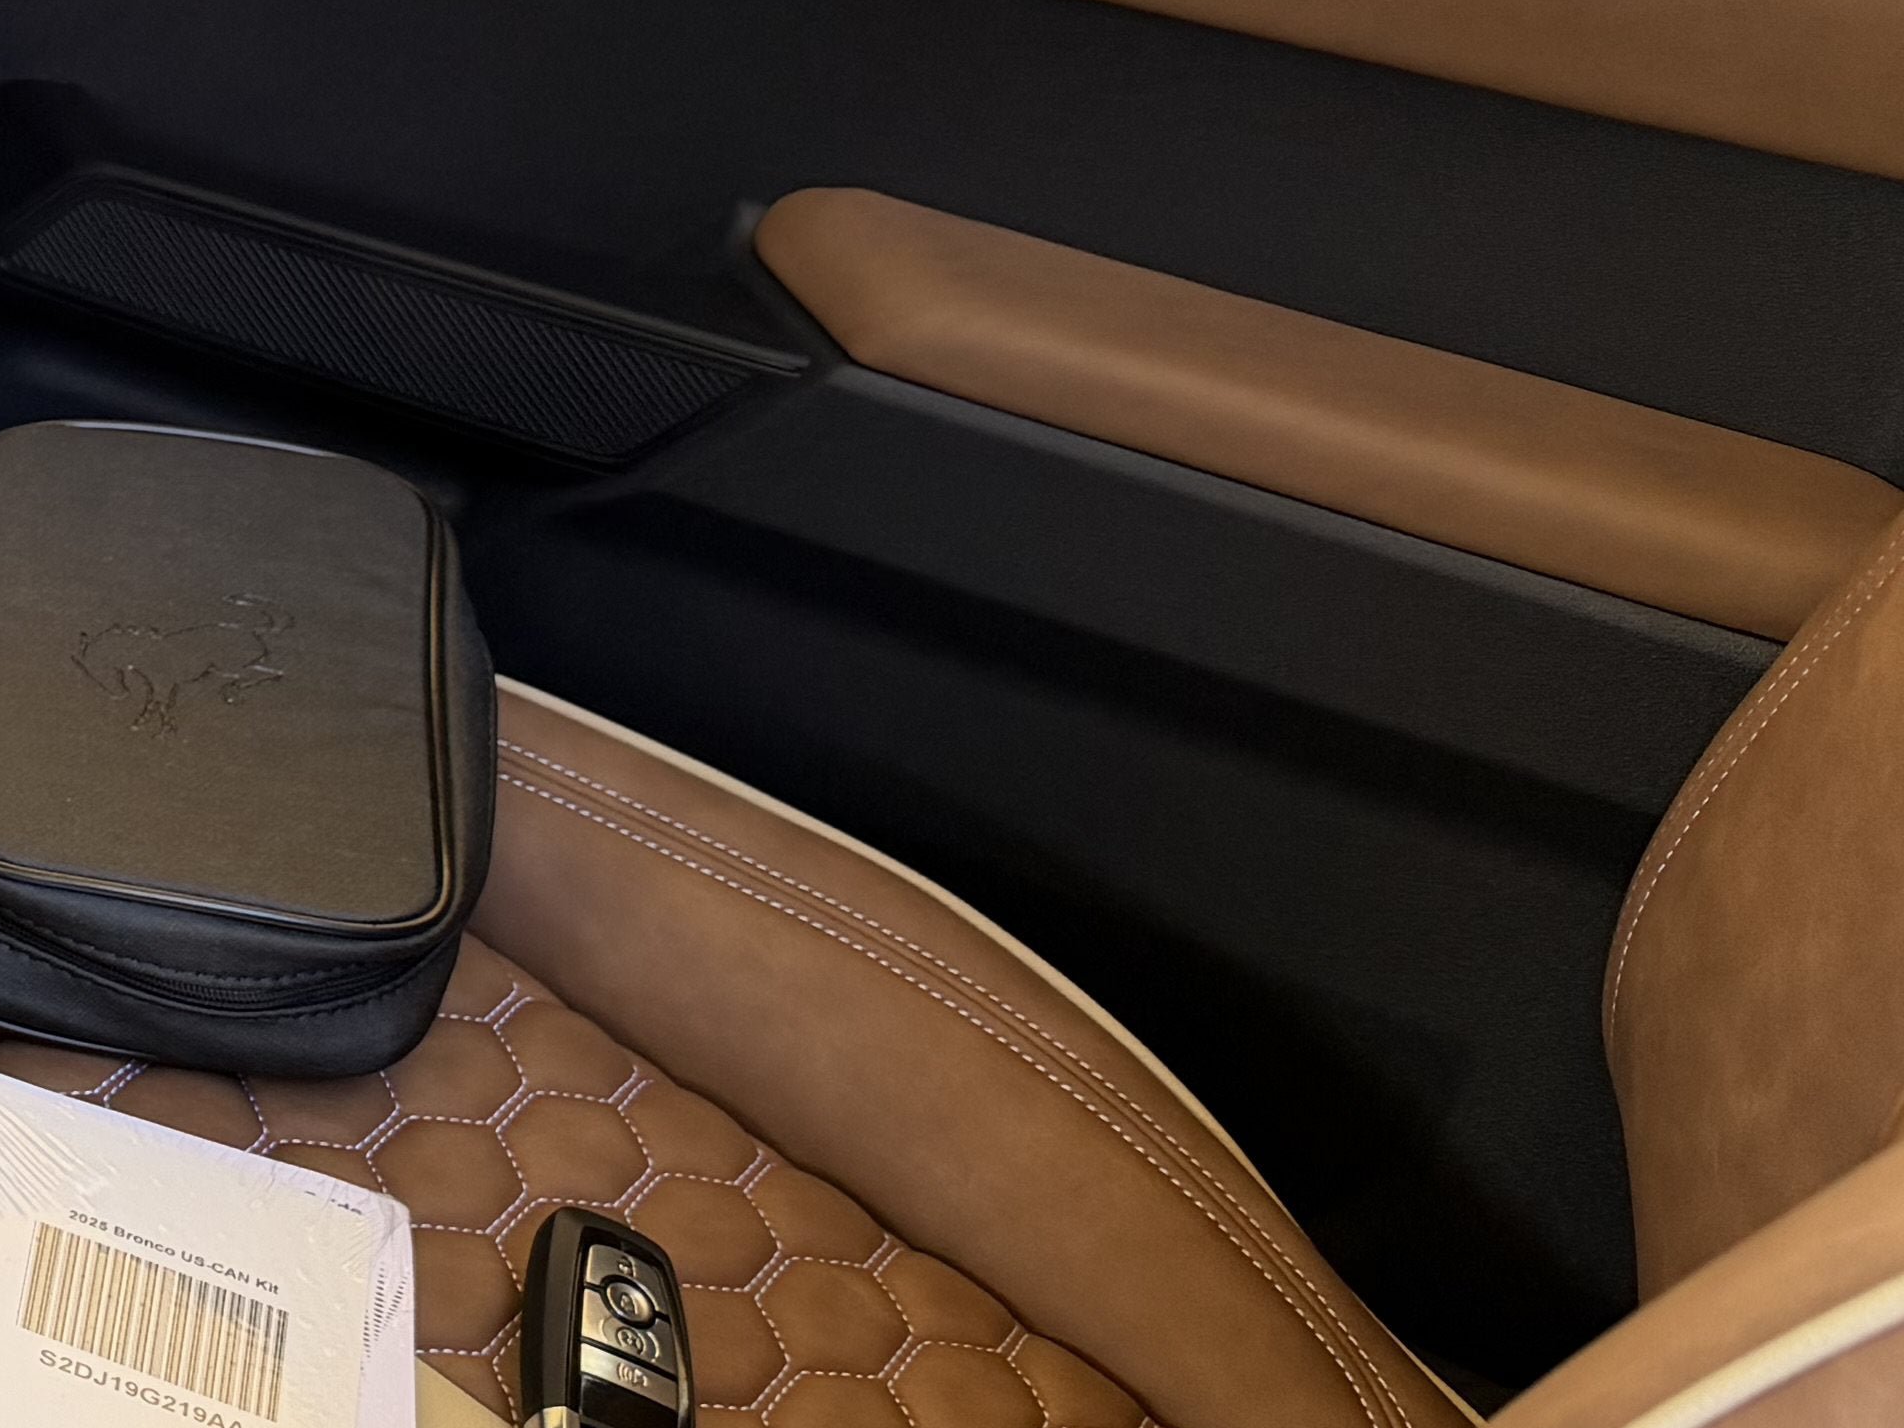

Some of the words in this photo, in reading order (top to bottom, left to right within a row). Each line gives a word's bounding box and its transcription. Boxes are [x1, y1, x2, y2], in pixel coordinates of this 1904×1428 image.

[68, 1210, 108, 1232] 2025
[114, 1226, 175, 1257] Bronco
[181, 1250, 250, 1284] US-CAN
[256, 1277, 280, 1295] Kit
